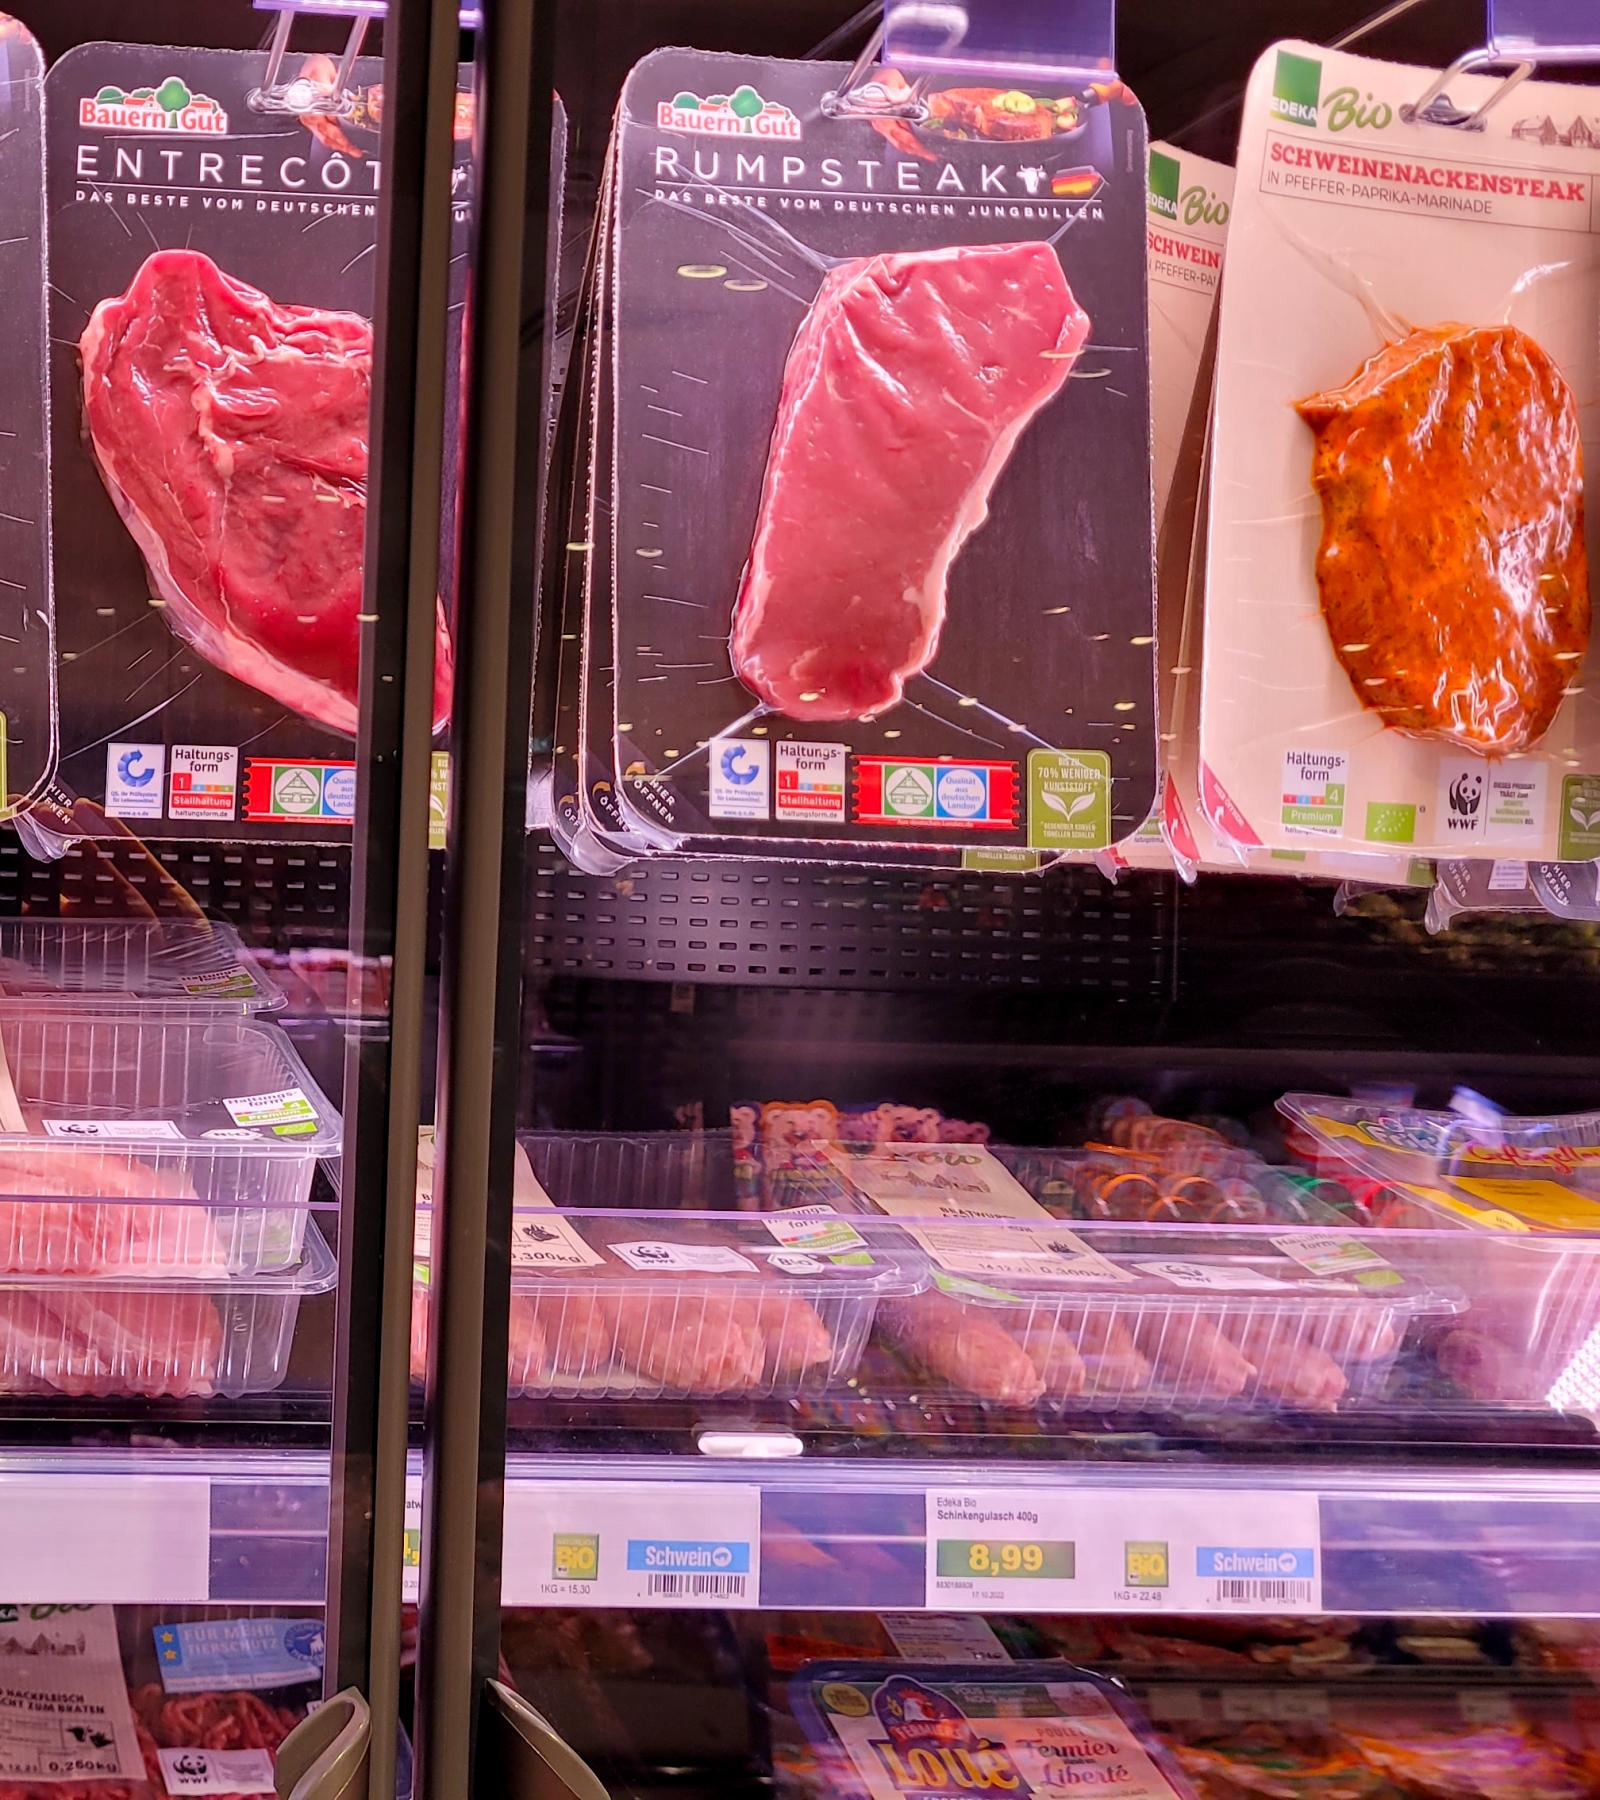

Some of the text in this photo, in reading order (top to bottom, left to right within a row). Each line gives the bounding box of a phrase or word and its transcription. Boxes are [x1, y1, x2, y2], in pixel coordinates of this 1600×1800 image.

[80, 102, 225, 132] Bauern Gut
[1271, 87, 1392, 132] EDEKA Bio
[659, 106, 798, 137] Bauern Gut
[76, 145, 381, 190] ENTRECÔT
[655, 146, 1007, 193] RUMPSTEAK
[1271, 142, 1586, 202] SCHWEINENACKENSTEAK
[1267, 170, 1493, 215] IN PFEFFER-PAPRIKA-MARINADE
[76, 190, 375, 216] DAS BESTE VOM DEUTSCHEN
[655, 189, 1103, 219] DAS BESTE VOM DEUTSCHEN JUNGBULLEN
[1180, 185, 1230, 226] Bio
[175, 749, 234, 762] Haltungs-
[780, 744, 841, 759] Haltungs-
[190, 761, 219, 772] form
[795, 757, 826, 771] form
[1287, 752, 1346, 770] Haltungs-
[784, 775, 792, 787] 1
[945, 776, 977, 786] Qualität
[1060, 767, 1101, 780] WENIGER
[1300, 766, 1330, 781] form
[179, 777, 185, 788] 1
[50, 783, 73, 808] HIER
[650, 779, 676, 807] HIER
[941, 793, 981, 802] deutschen
[1329, 788, 1339, 802] 4
[174, 796, 232, 808] Stallhaltung
[633, 779, 675, 824] ÖFFNEN
[780, 795, 841, 808] Stallhaltung
[947, 801, 976, 811] Landen
[175, 809, 228, 818] haltungsform.de
[782, 809, 838, 819] haltungsform.de
[1291, 809, 1334, 823] Premium
[1447, 818, 1479, 830] WWF
[1540, 862, 1570, 906] ÖFFNEN
[1553, 864, 1572, 890] HIER
[227, 1090, 297, 1105] Haltungs-
[247, 1097, 284, 1107] form
[936, 1497, 977, 1507] Edeka Bio
[936, 1509, 1039, 1523] Schinkengulasch 400g
[645, 1545, 712, 1567] Schwein
[968, 1543, 1044, 1577] 8,99
[1213, 1551, 1278, 1573] Schwein
[540, 1584, 591, 1594] 1KG 15.30
[1113, 1591, 1130, 1601] 1KG
[183, 1623, 275, 1642] FÜR MEHR
[187, 1638, 279, 1655] TIERSCHUTZ
[1015, 1740, 1119, 1760] Fermier
[878, 1738, 1020, 1790] Loué
[1040, 1764, 1132, 1787] Liberté
